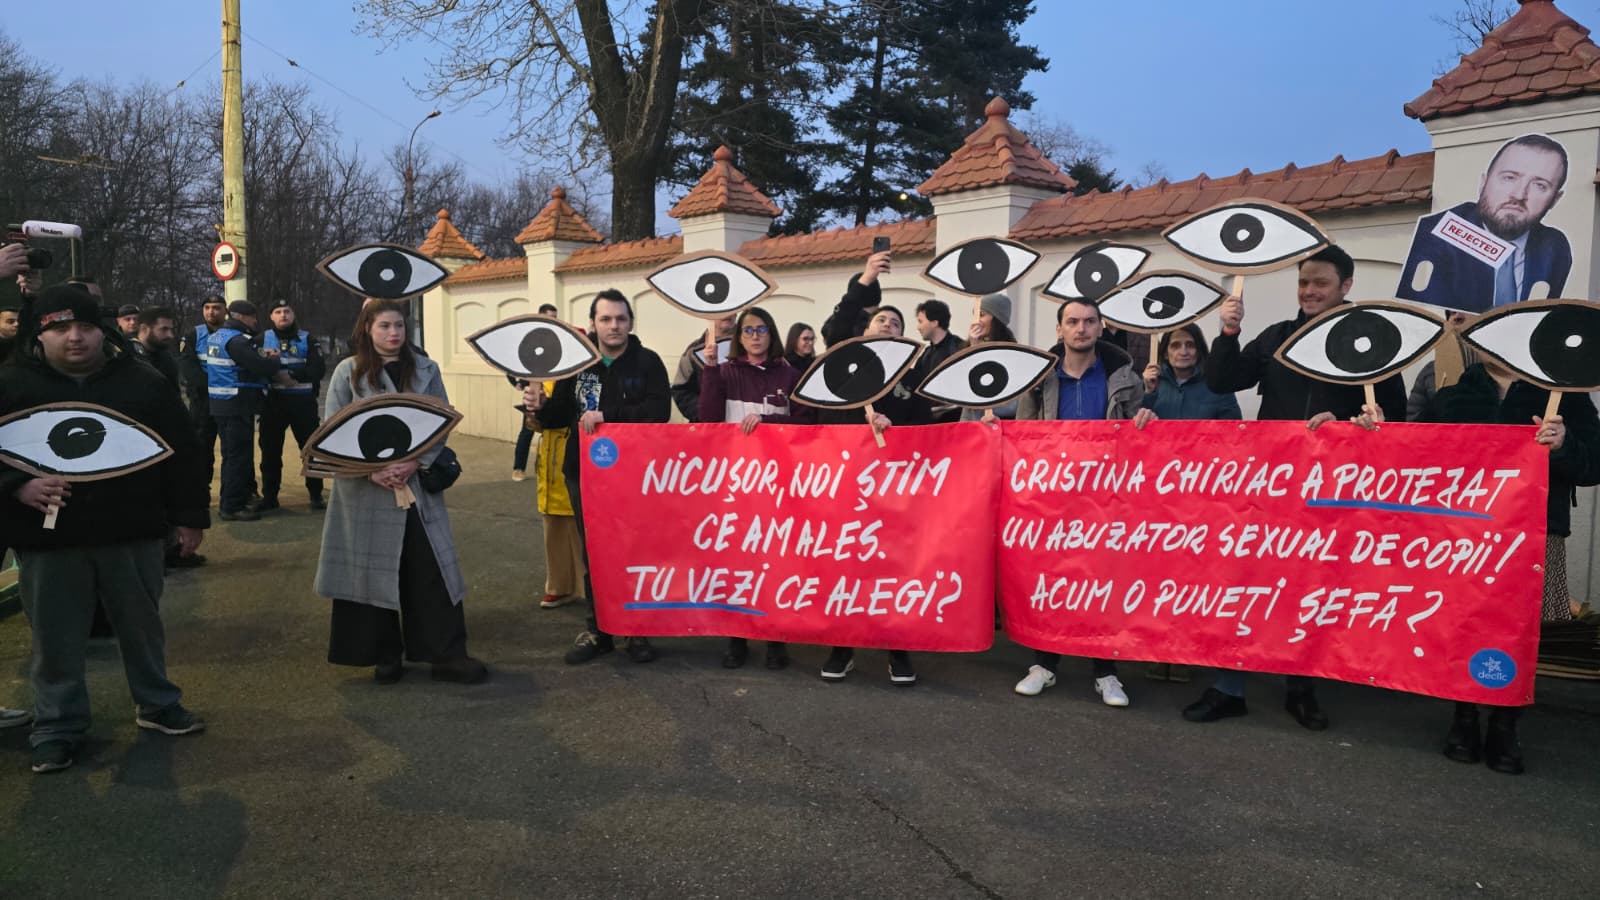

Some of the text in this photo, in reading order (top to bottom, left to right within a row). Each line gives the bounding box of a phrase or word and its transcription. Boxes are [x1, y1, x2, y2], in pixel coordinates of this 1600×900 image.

[1448, 224, 1499, 256] REJECTED
[789, 449, 851, 499] NOI
[1010, 451, 1521, 512] CRISTINA CHIRIAC A PROTEJAT
[693, 512, 887, 562] CE AM ALES.
[1002, 516, 1526, 586] UN ABUZATOR SEXUAL DE COPII!
[626, 562, 963, 623] TU VEZI CE ALEGI?
[1030, 573, 1113, 612] ACUM
[1123, 579, 1146, 614] O
[1478, 670, 1508, 681] declic
